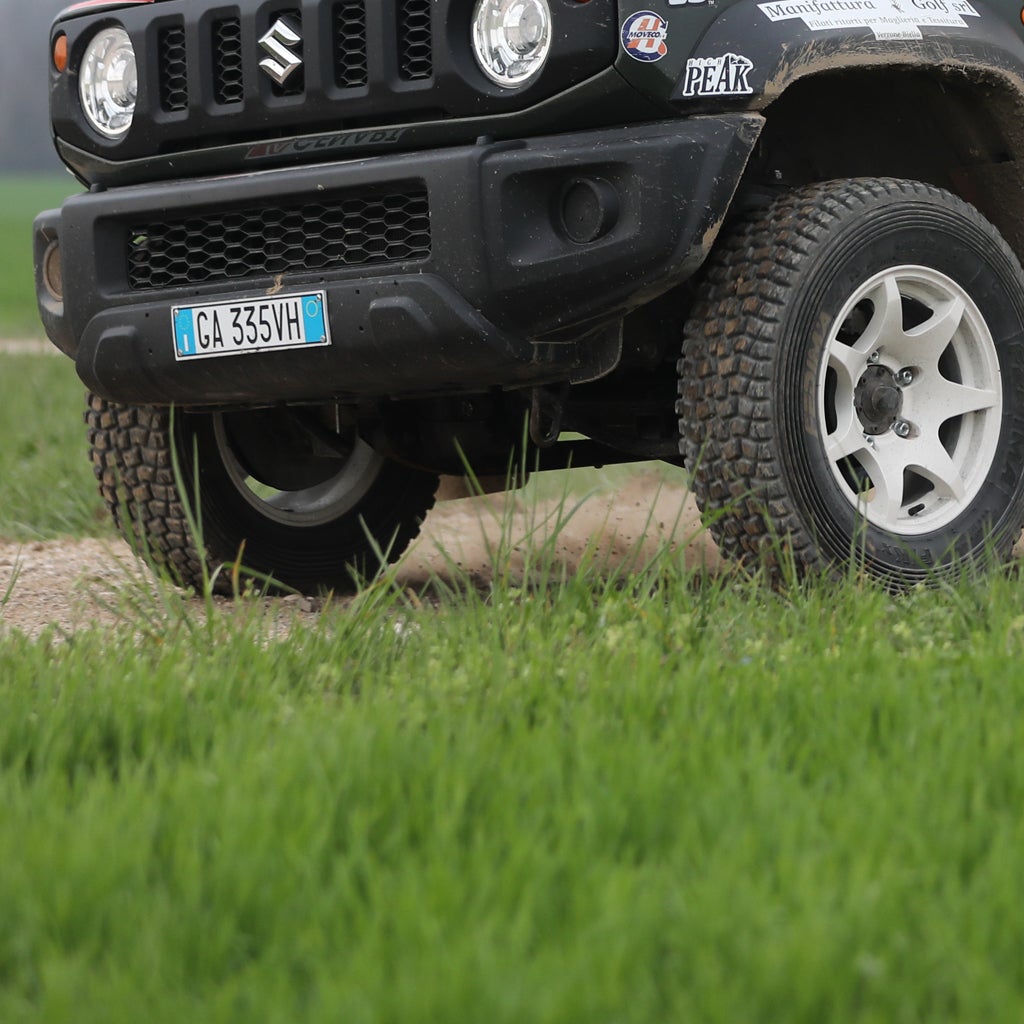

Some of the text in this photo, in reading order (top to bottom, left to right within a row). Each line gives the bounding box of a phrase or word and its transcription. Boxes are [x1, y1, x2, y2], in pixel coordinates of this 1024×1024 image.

[765, 0, 876, 19] Manifattura
[953, 0, 976, 14] srl
[864, 17, 878, 26] per
[685, 55, 750, 93] PEAK
[197, 301, 301, 350] GA 335VH
